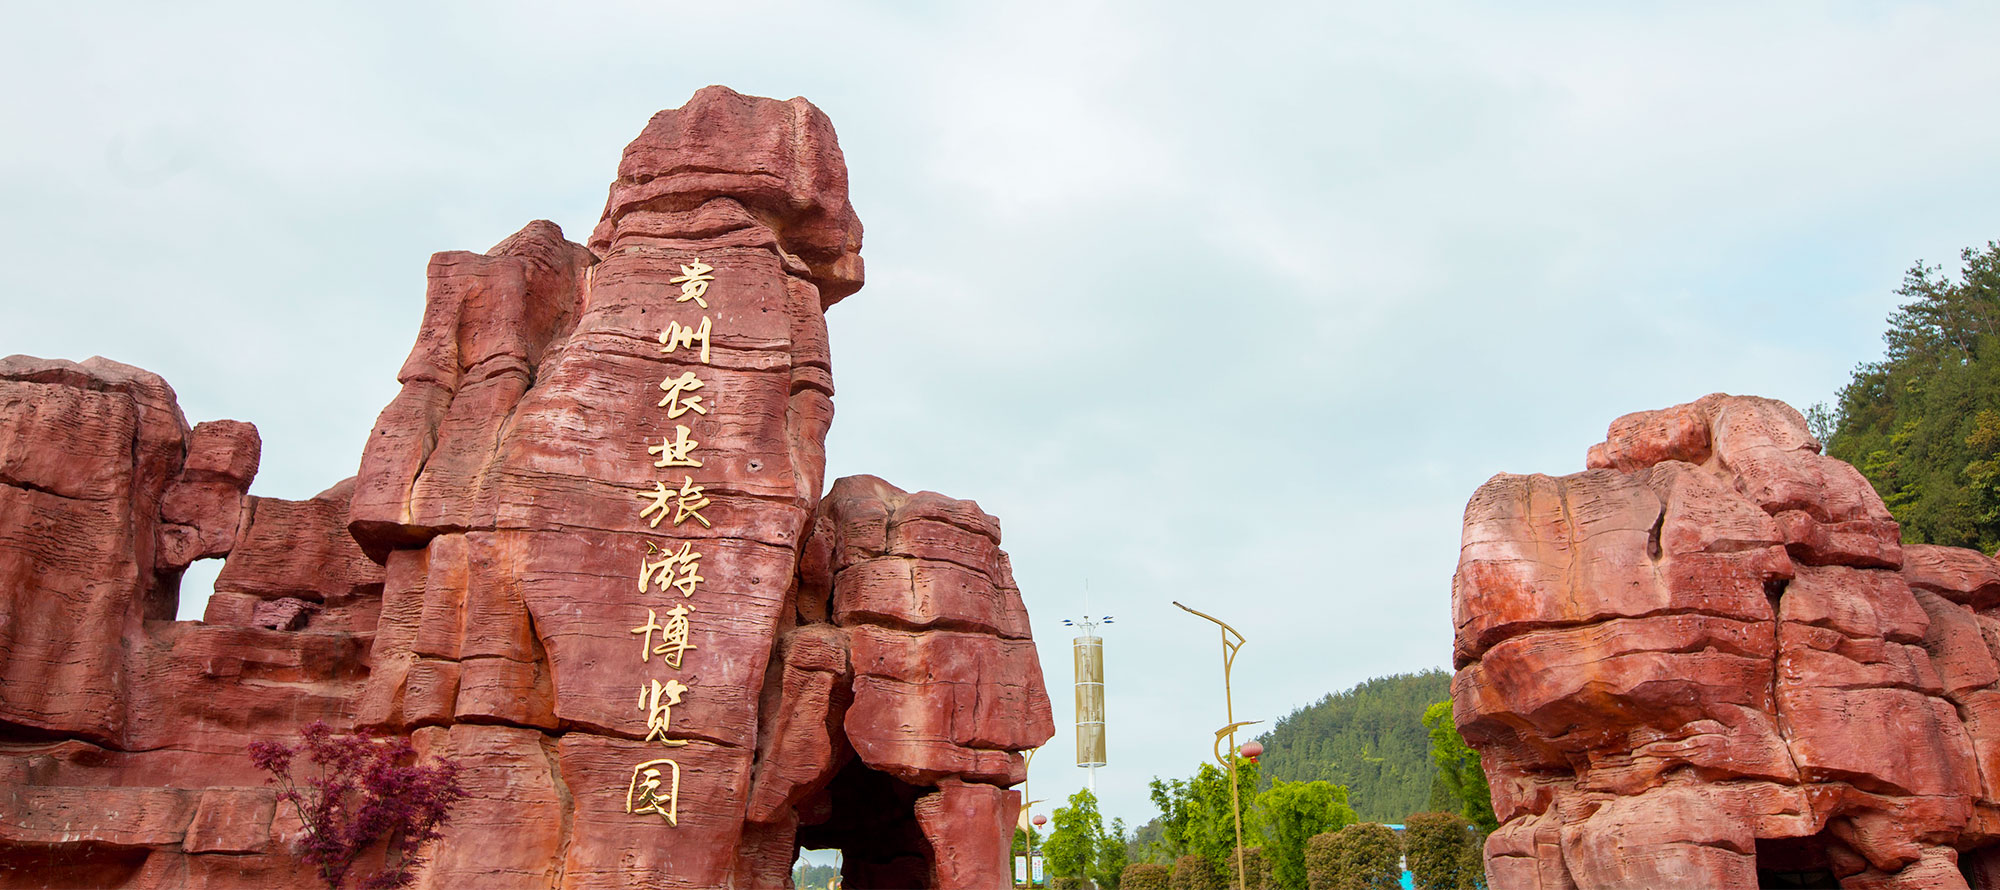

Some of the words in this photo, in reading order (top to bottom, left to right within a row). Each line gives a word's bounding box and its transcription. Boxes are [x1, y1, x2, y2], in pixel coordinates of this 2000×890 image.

[626, 257, 715, 827] 贵州农业旅游博览园
